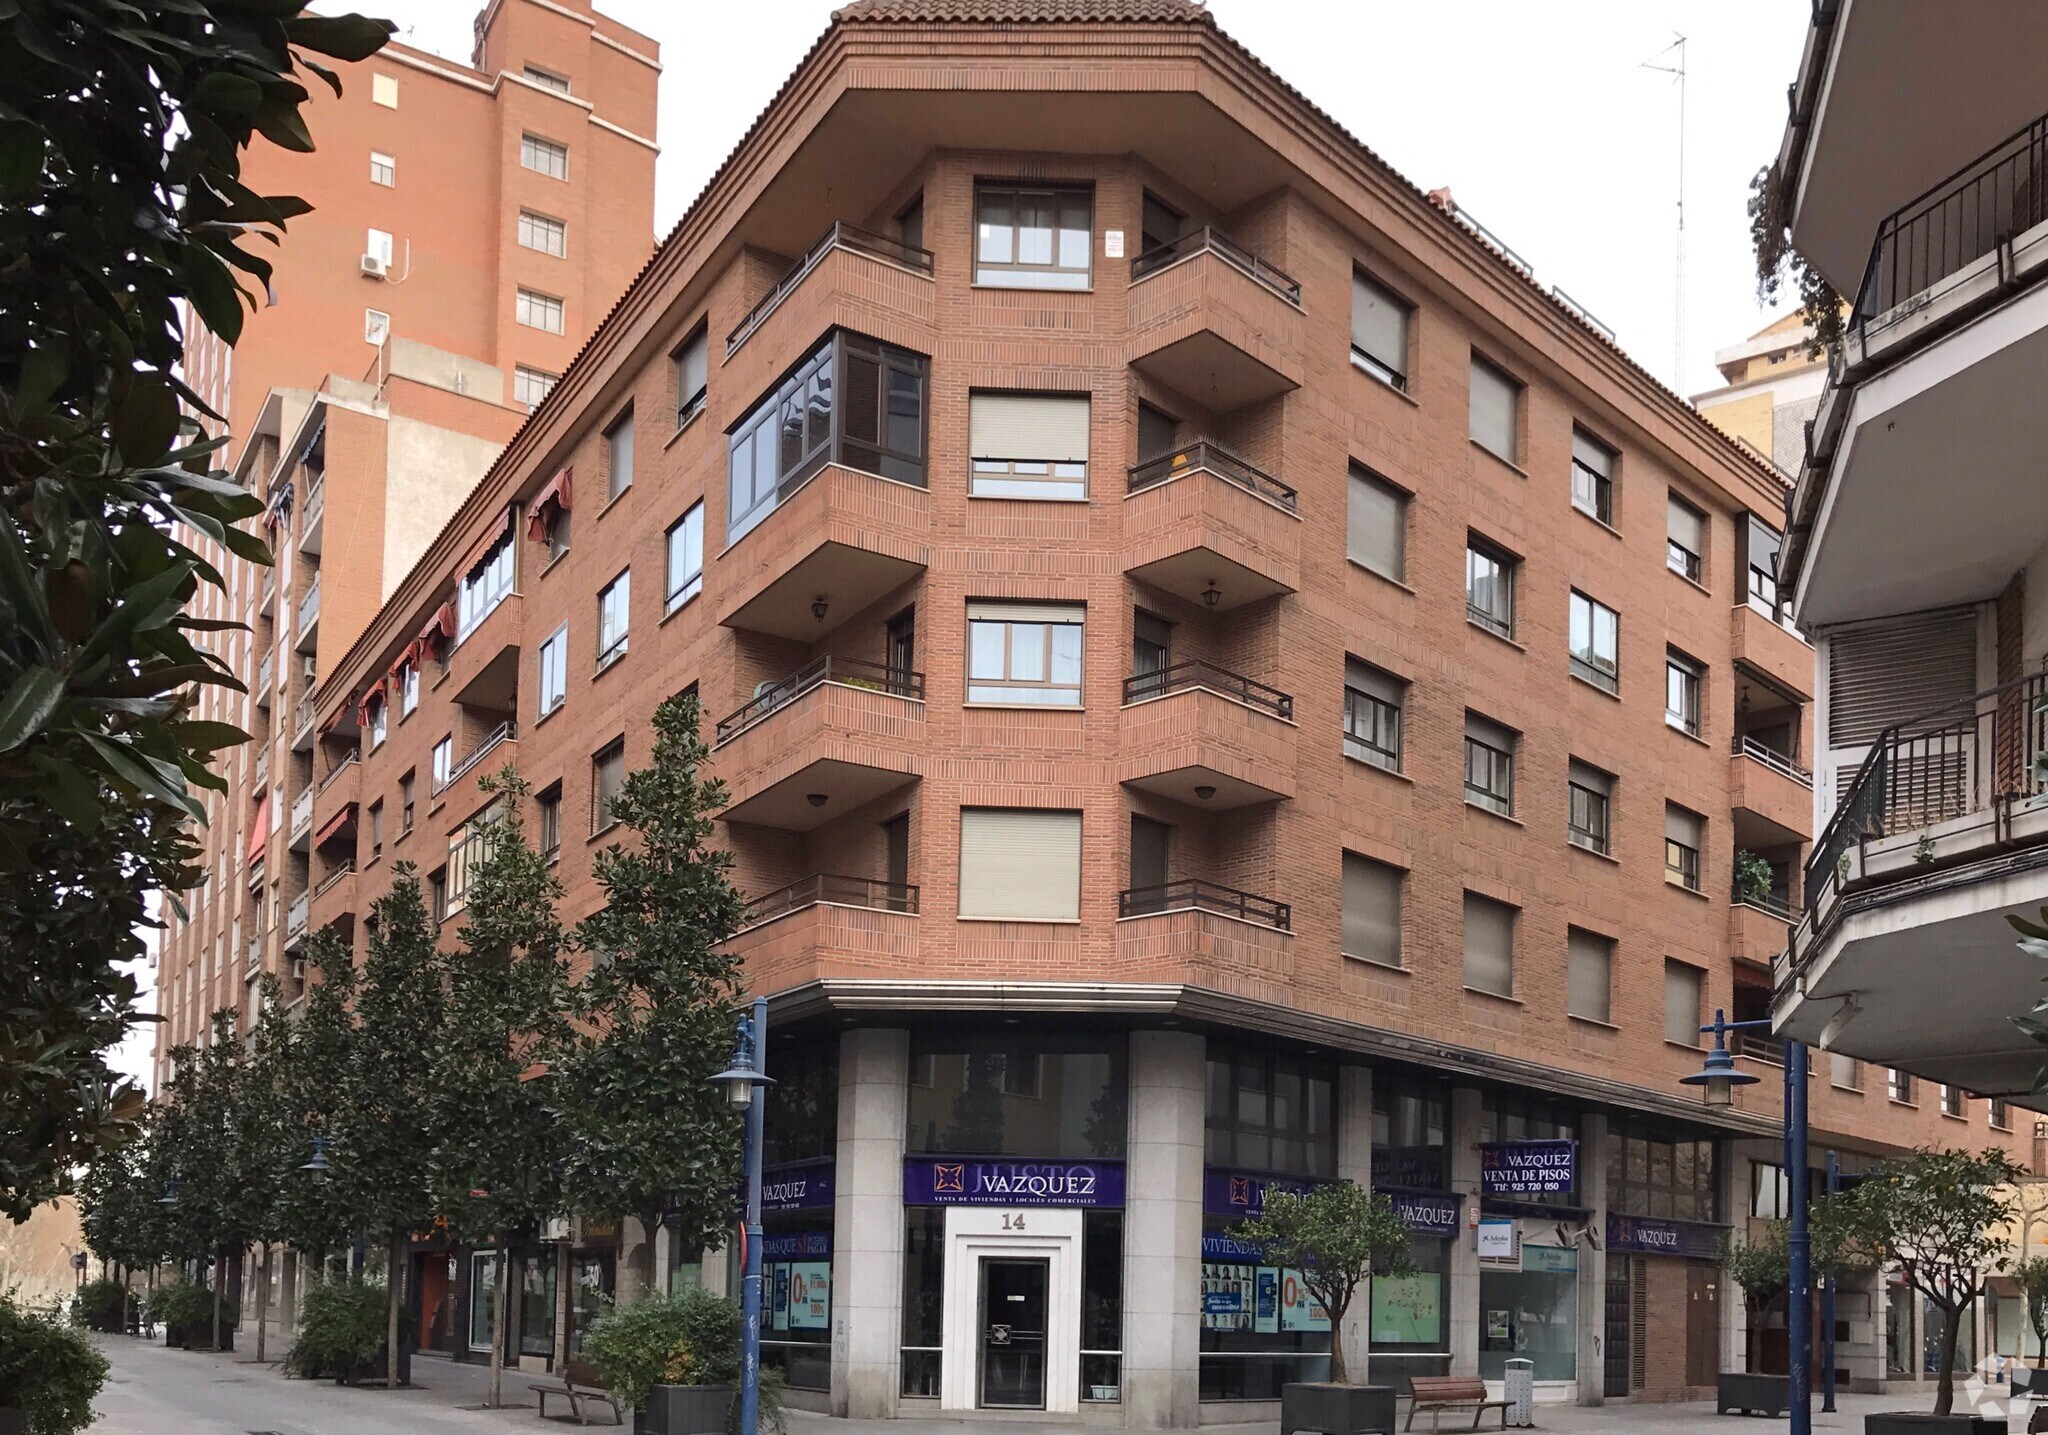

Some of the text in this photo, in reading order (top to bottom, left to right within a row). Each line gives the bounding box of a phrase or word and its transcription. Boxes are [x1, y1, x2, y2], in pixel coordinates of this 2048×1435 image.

[1508, 1154, 1571, 1168] VAZQUEZ
[972, 1163, 1096, 1193] JUSTO
[1484, 1169, 1570, 1182] VENTA DE PISOS
[763, 1180, 807, 1202] VAZQUEZ
[982, 1175, 1096, 1197] VAZQUEZ
[1512, 1182, 1525, 1191] 925
[1528, 1182, 1542, 1190] 720
[1544, 1182, 1559, 1190] 050
[1001, 1213, 1026, 1230] 14
[1401, 1205, 1455, 1225] VAZQUEZ
[1637, 1229, 1677, 1246] VAZQUEZ
[780, 1238, 797, 1255] QUE
[1203, 1238, 1263, 1255] VIVIENDAS
